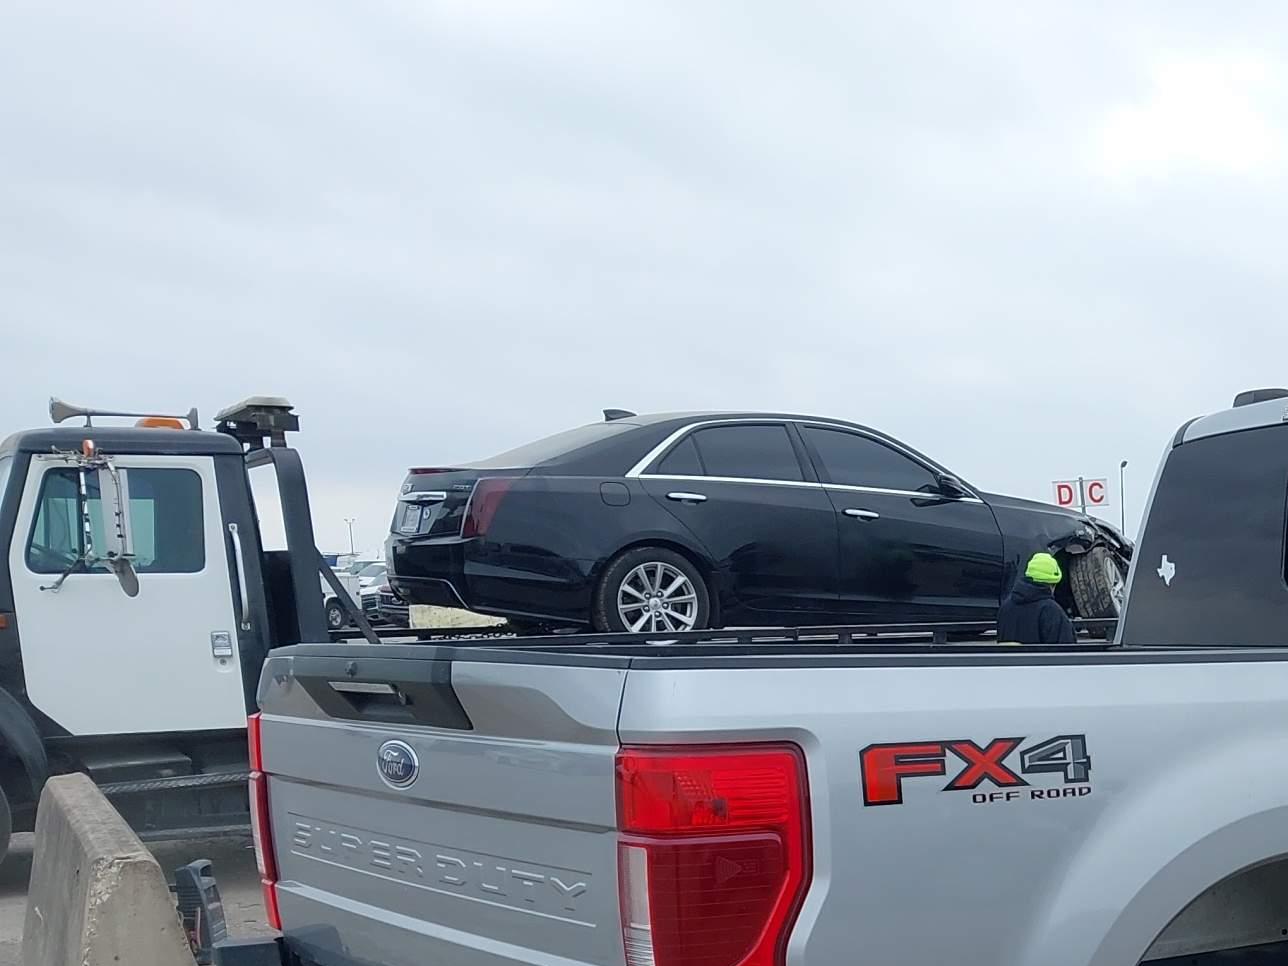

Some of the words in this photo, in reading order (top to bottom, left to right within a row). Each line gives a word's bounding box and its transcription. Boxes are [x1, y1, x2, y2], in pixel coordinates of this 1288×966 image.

[1057, 486, 1073, 505] D
[1088, 482, 1105, 503] C
[381, 750, 405, 778] Ford
[859, 734, 1092, 807] FX4
[972, 791, 1020, 804] OFF
[1030, 786, 1092, 801] ROAD
[291, 821, 424, 876] SUPER
[436, 852, 588, 912] DUTY
